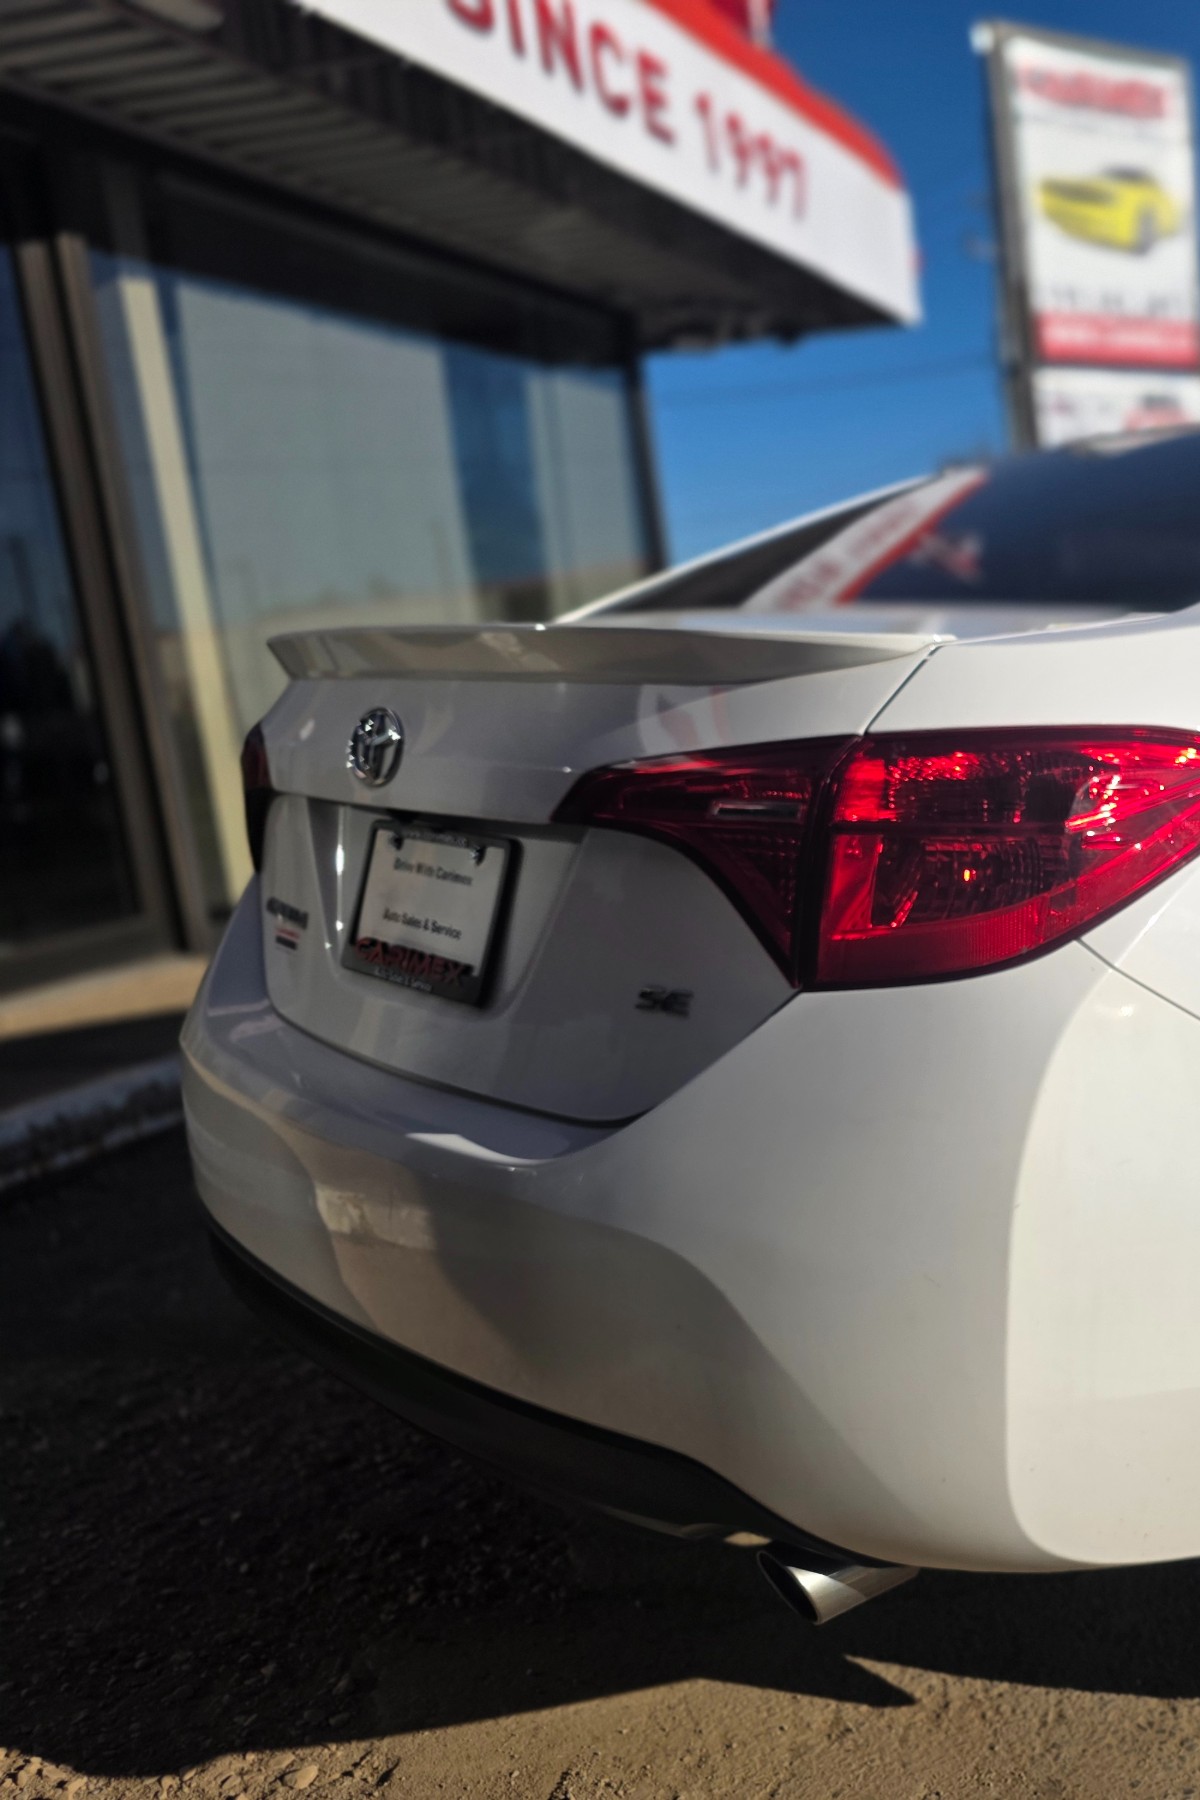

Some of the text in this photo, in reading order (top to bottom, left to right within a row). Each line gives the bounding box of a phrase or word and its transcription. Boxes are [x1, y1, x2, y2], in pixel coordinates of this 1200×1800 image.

[694, 92, 808, 222] 1997
[431, 919, 462, 940] Service
[354, 937, 463, 983] CARIMEX
